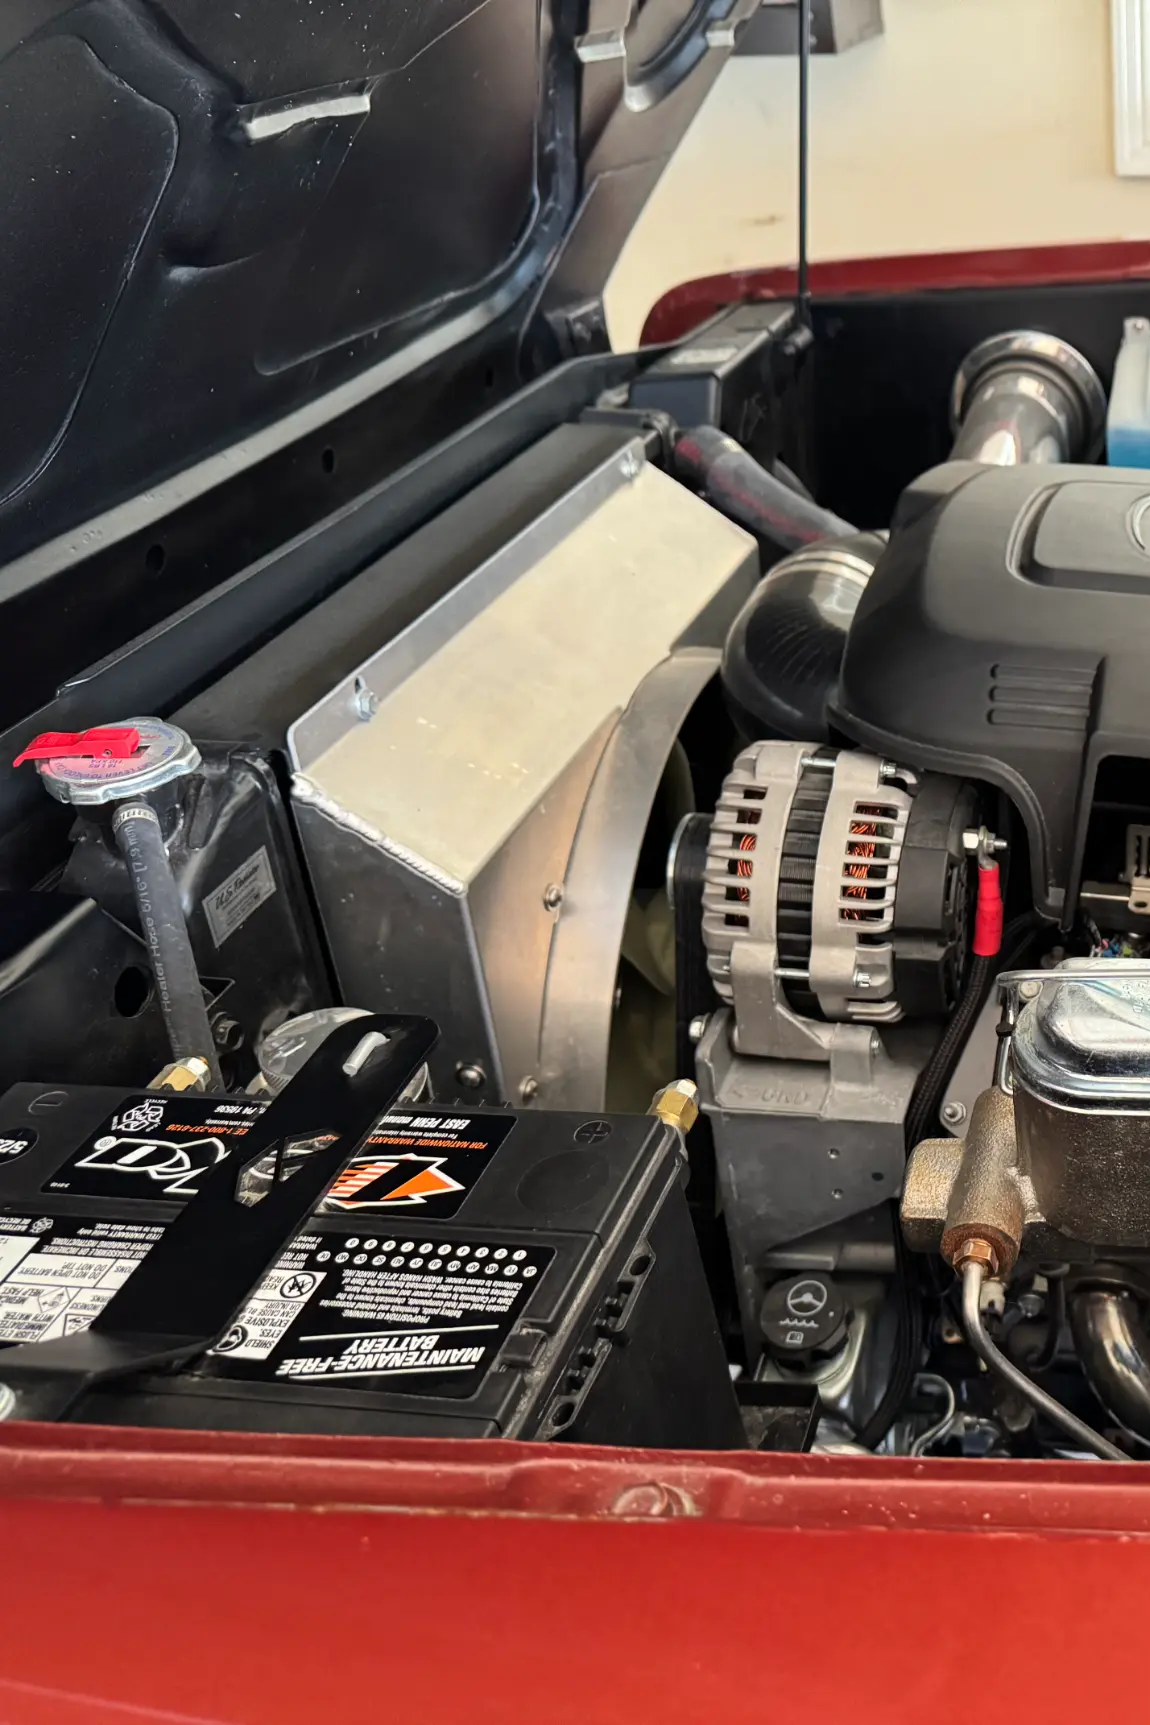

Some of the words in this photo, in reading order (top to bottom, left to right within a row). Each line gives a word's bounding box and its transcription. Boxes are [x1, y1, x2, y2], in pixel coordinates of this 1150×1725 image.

[242, 1106, 257, 1114] PA
[409, 1116, 442, 1128] PENN
[440, 1118, 471, 1130] EAST
[366, 1136, 416, 1146] WARRANTY
[414, 1138, 470, 1148] NATIONWIDE
[74, 1263, 95, 1271] NOT
[94, 1264, 108, 1272] DO
[51, 1269, 72, 1278] OPEN
[70, 1270, 89, 1279] NOT
[88, 1272, 100, 1280] DO
[376, 1272, 400, 1280] AFTER
[22, 1288, 44, 1296] HELP
[264, 1302, 290, 1310] INJURY
[257, 1308, 280, 1317] CAUSE
[281, 1310, 296, 1318] CAN
[32, 1314, 54, 1322] WITH
[244, 1316, 290, 1328] EXPLOSIVE
[14, 1331, 38, 1340] FLUSH
[244, 1339, 275, 1348] SHIELD
[342, 1334, 440, 1354] BATTERY
[275, 1346, 486, 1375] MAINTENANCE-FREE
